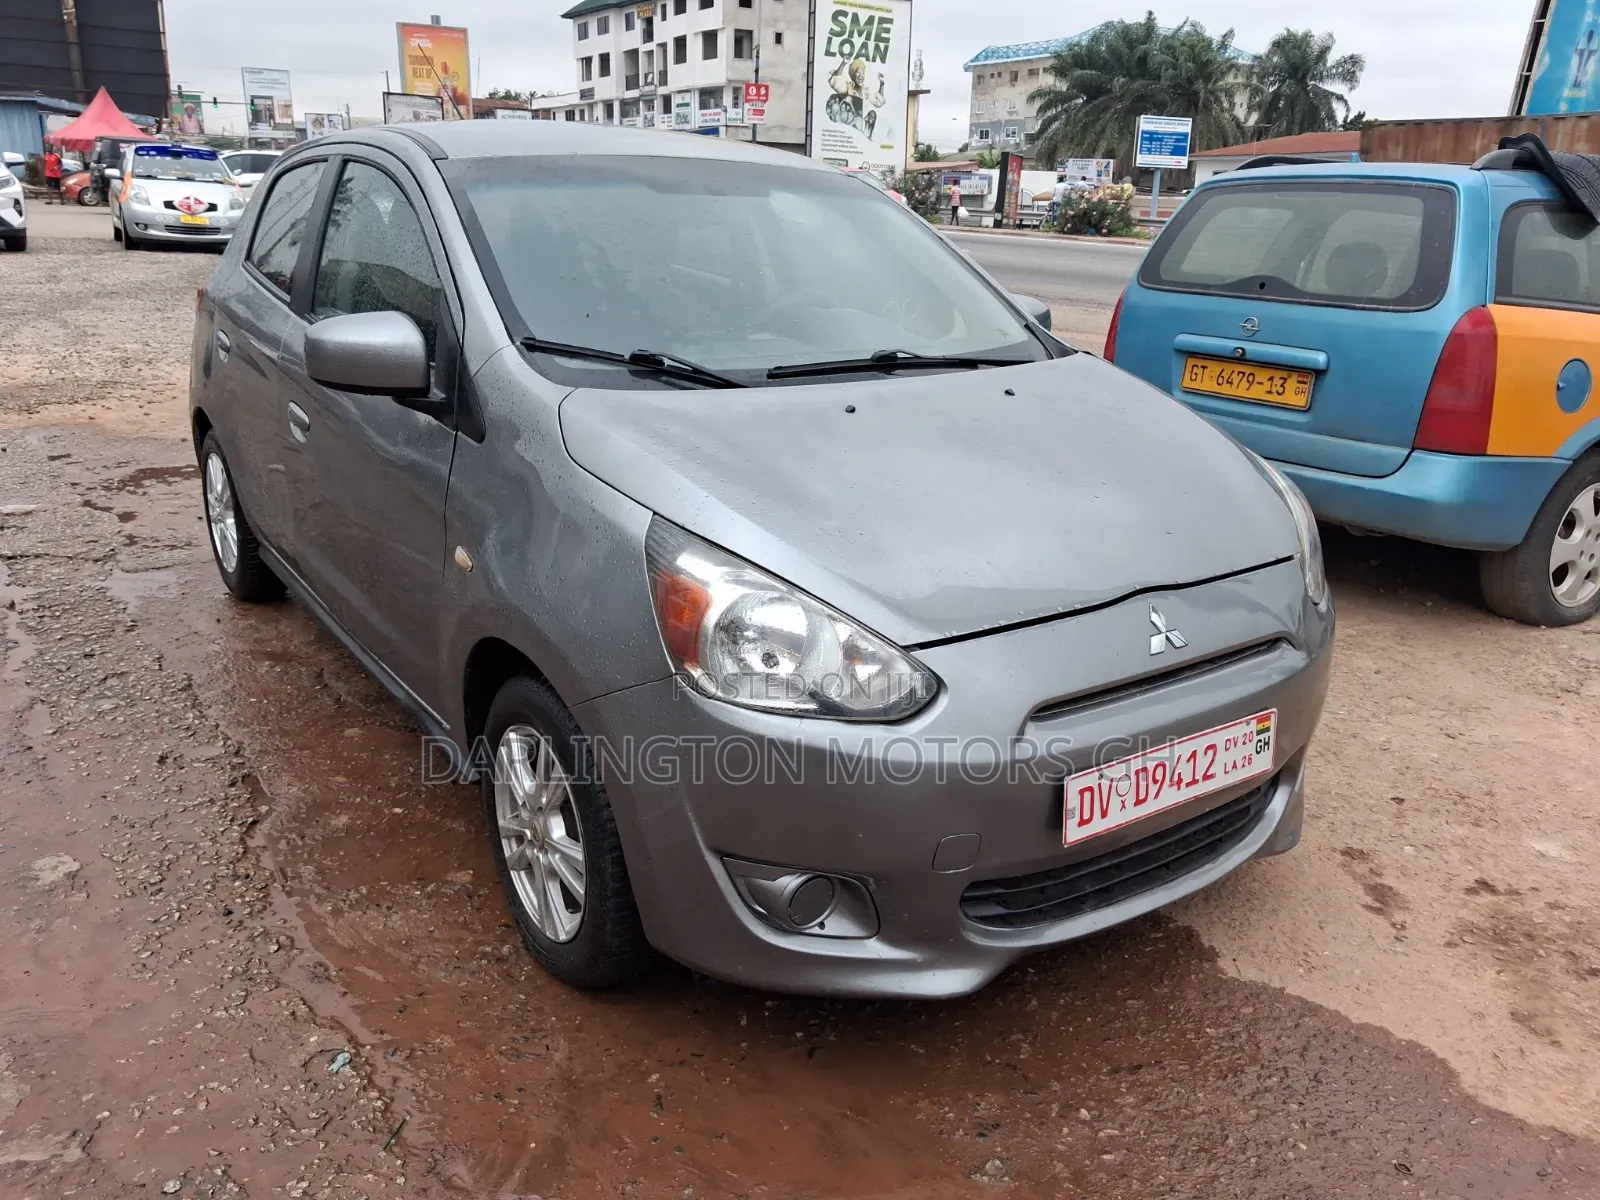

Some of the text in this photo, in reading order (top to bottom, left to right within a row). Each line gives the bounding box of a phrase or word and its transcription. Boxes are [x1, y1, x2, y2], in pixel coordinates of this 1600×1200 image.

[828, 9, 894, 44] SME
[824, 36, 889, 64] LOAN
[1189, 364, 1288, 396] GT 6479-13
[1294, 386, 1307, 397] GH
[1224, 730, 1254, 751] DV 20
[1255, 735, 1270, 755] GH
[1223, 758, 1238, 775] LA
[1077, 743, 1218, 828] DV D9412
